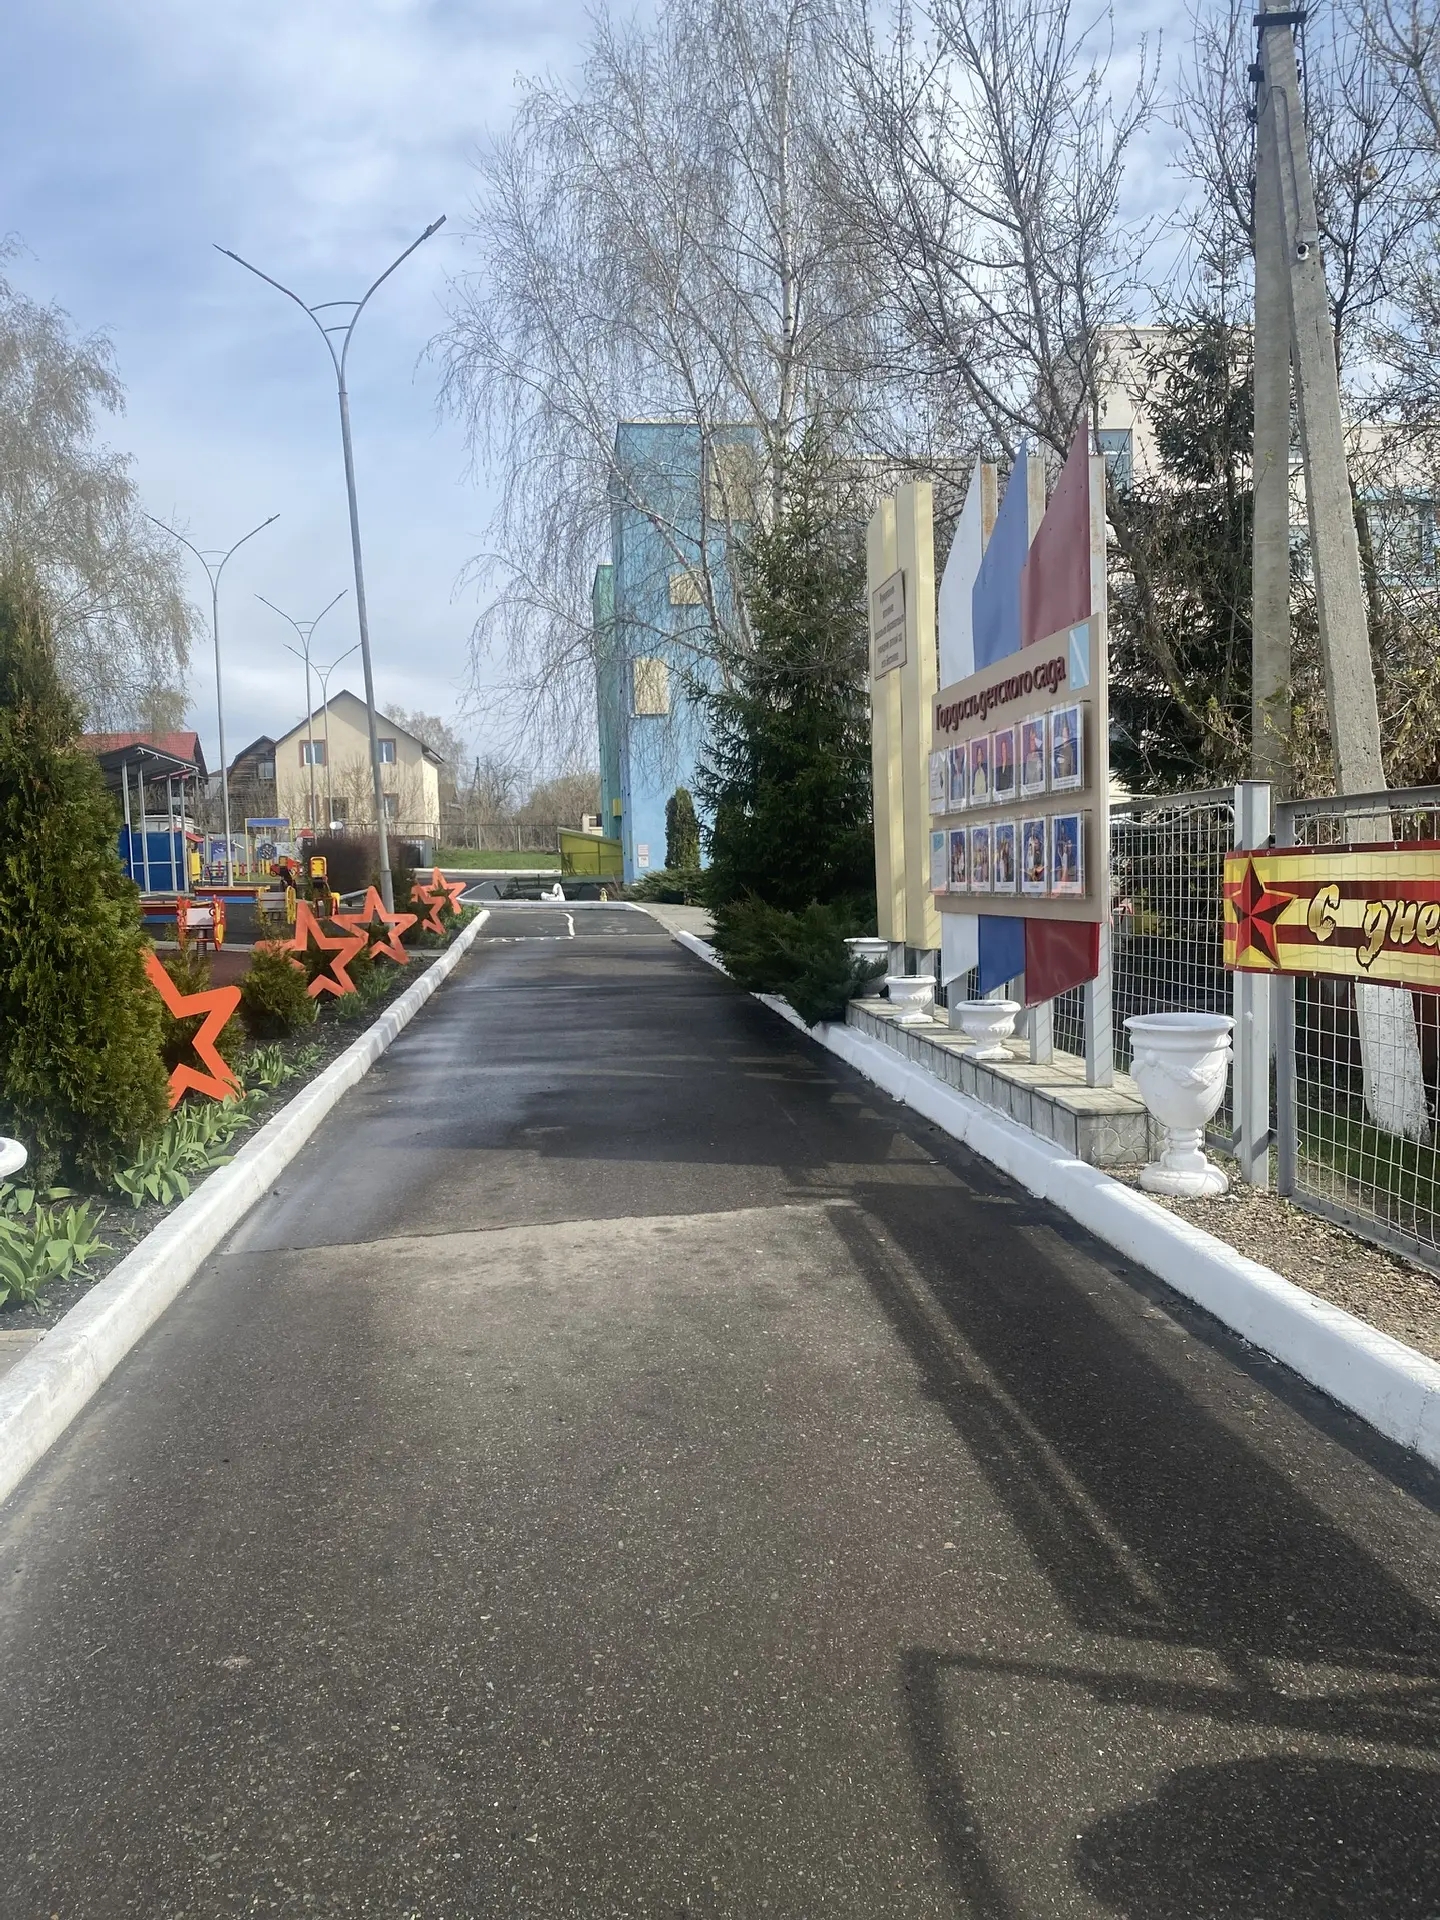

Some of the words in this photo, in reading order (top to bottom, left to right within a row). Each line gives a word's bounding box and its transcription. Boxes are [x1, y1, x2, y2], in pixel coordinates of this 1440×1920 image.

[936, 694, 979, 734] Гордость
[979, 670, 1033, 721] детского
[1033, 656, 1067, 694] сада
[1307, 883, 1341, 942] С
[1356, 898, 1440, 972] дне
